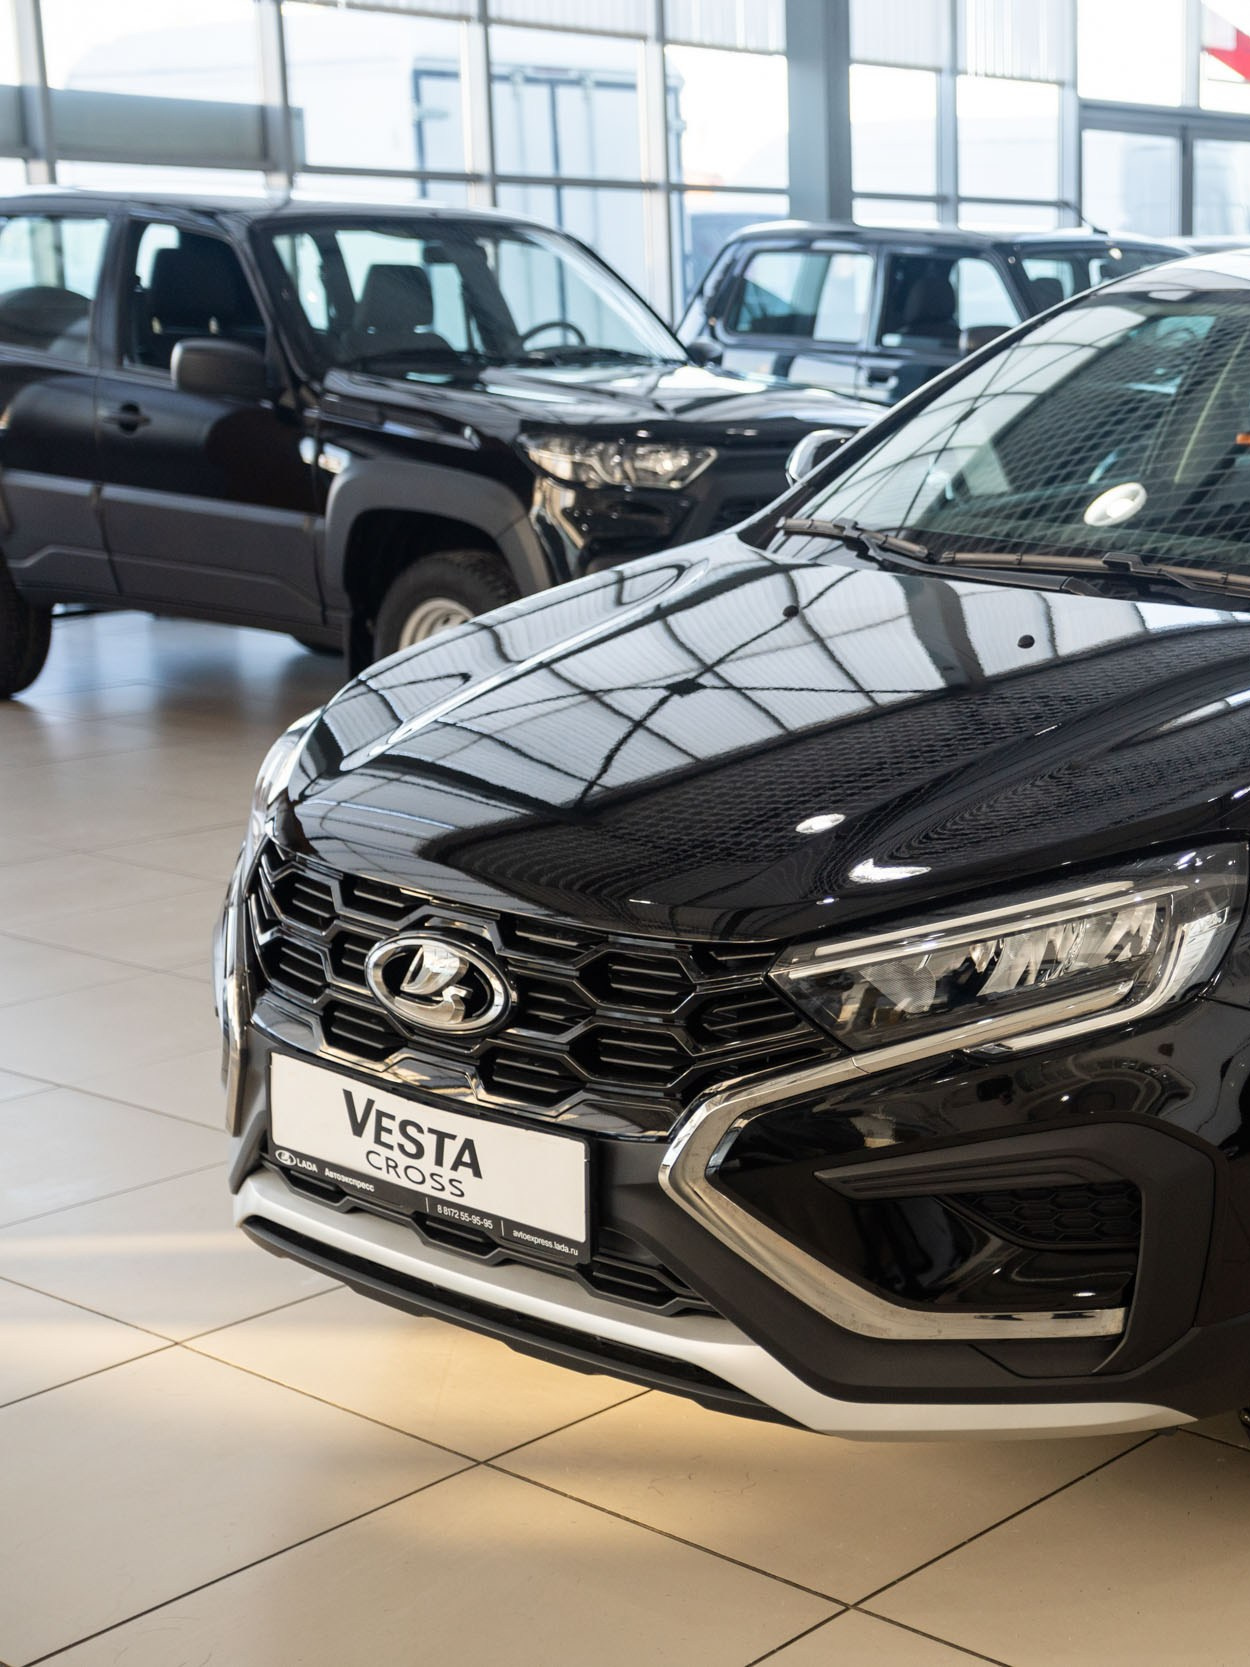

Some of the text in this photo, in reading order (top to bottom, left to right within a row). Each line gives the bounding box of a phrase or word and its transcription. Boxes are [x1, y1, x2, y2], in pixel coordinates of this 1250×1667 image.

[296, 1158, 375, 1192] LADA Автоэкспресс
[365, 1150, 465, 1198] CROSS
[436, 1204, 493, 1230] 8 8172 55-95-95
[512, 1229, 578, 1256] avtoexpress.lada.ru
